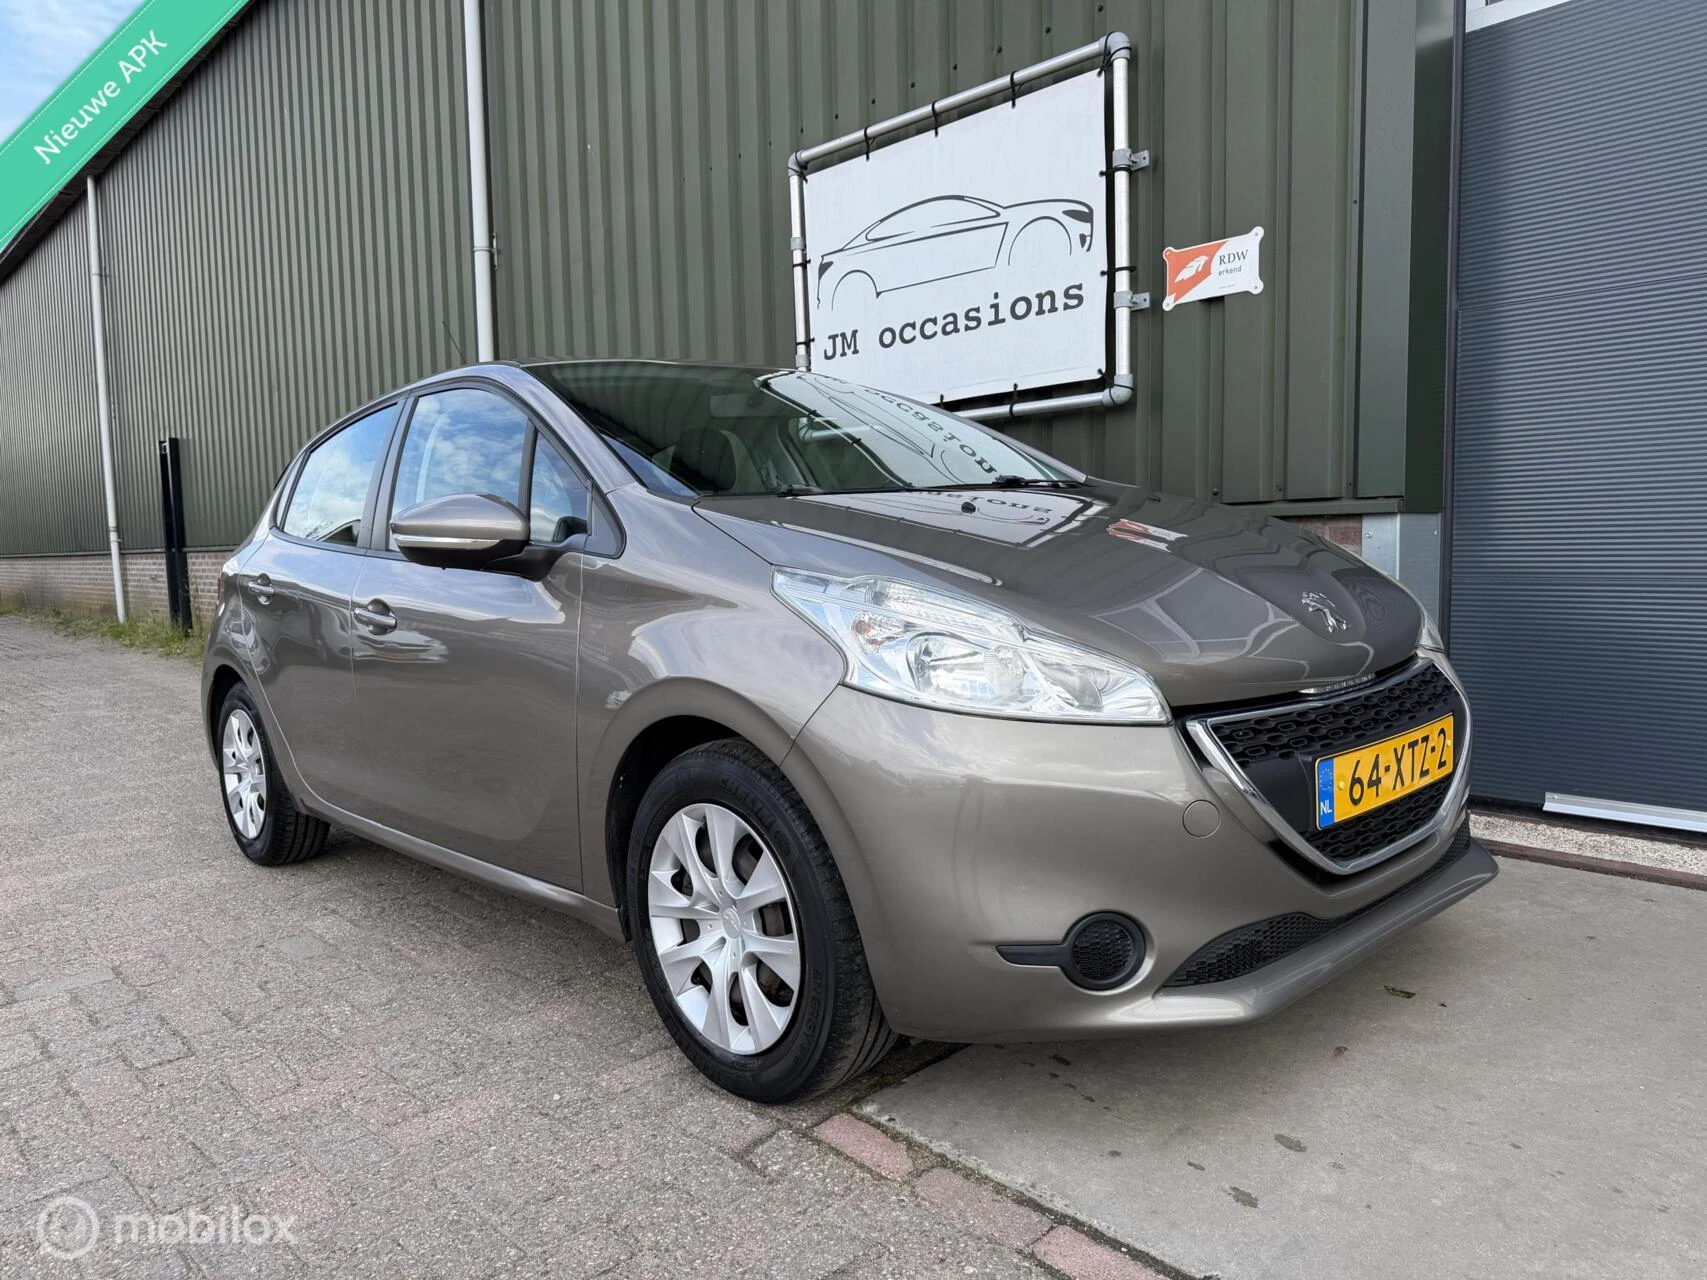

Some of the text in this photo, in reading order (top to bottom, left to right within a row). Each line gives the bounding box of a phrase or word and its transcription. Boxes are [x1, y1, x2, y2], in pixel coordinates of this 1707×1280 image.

[1219, 249, 1248, 265] RDW
[1219, 266, 1241, 276] erkend
[824, 283, 1084, 360] JM occasions
[1349, 727, 1447, 806] 64-XTZ-2
[1320, 801, 1333, 816] NL
